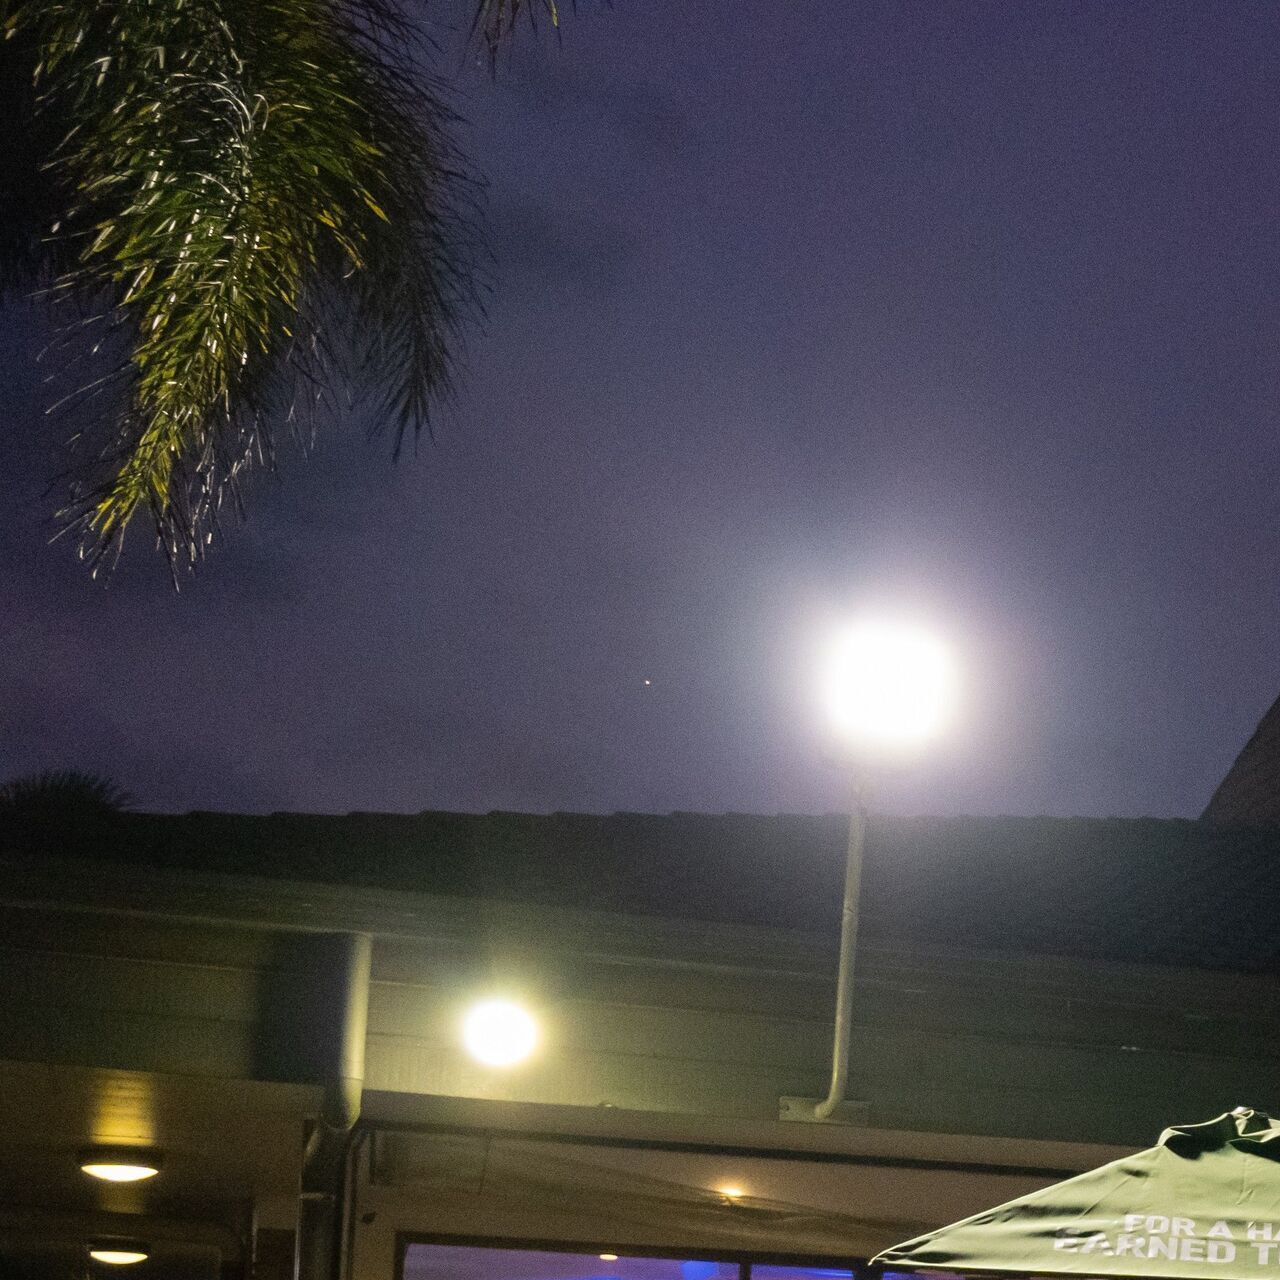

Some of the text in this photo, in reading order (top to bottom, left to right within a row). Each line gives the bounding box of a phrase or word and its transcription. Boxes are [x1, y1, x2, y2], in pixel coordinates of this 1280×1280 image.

[1124, 1214, 1196, 1235] FOR
[1206, 1220, 1235, 1238] A
[1053, 1233, 1237, 1264] EARNED
